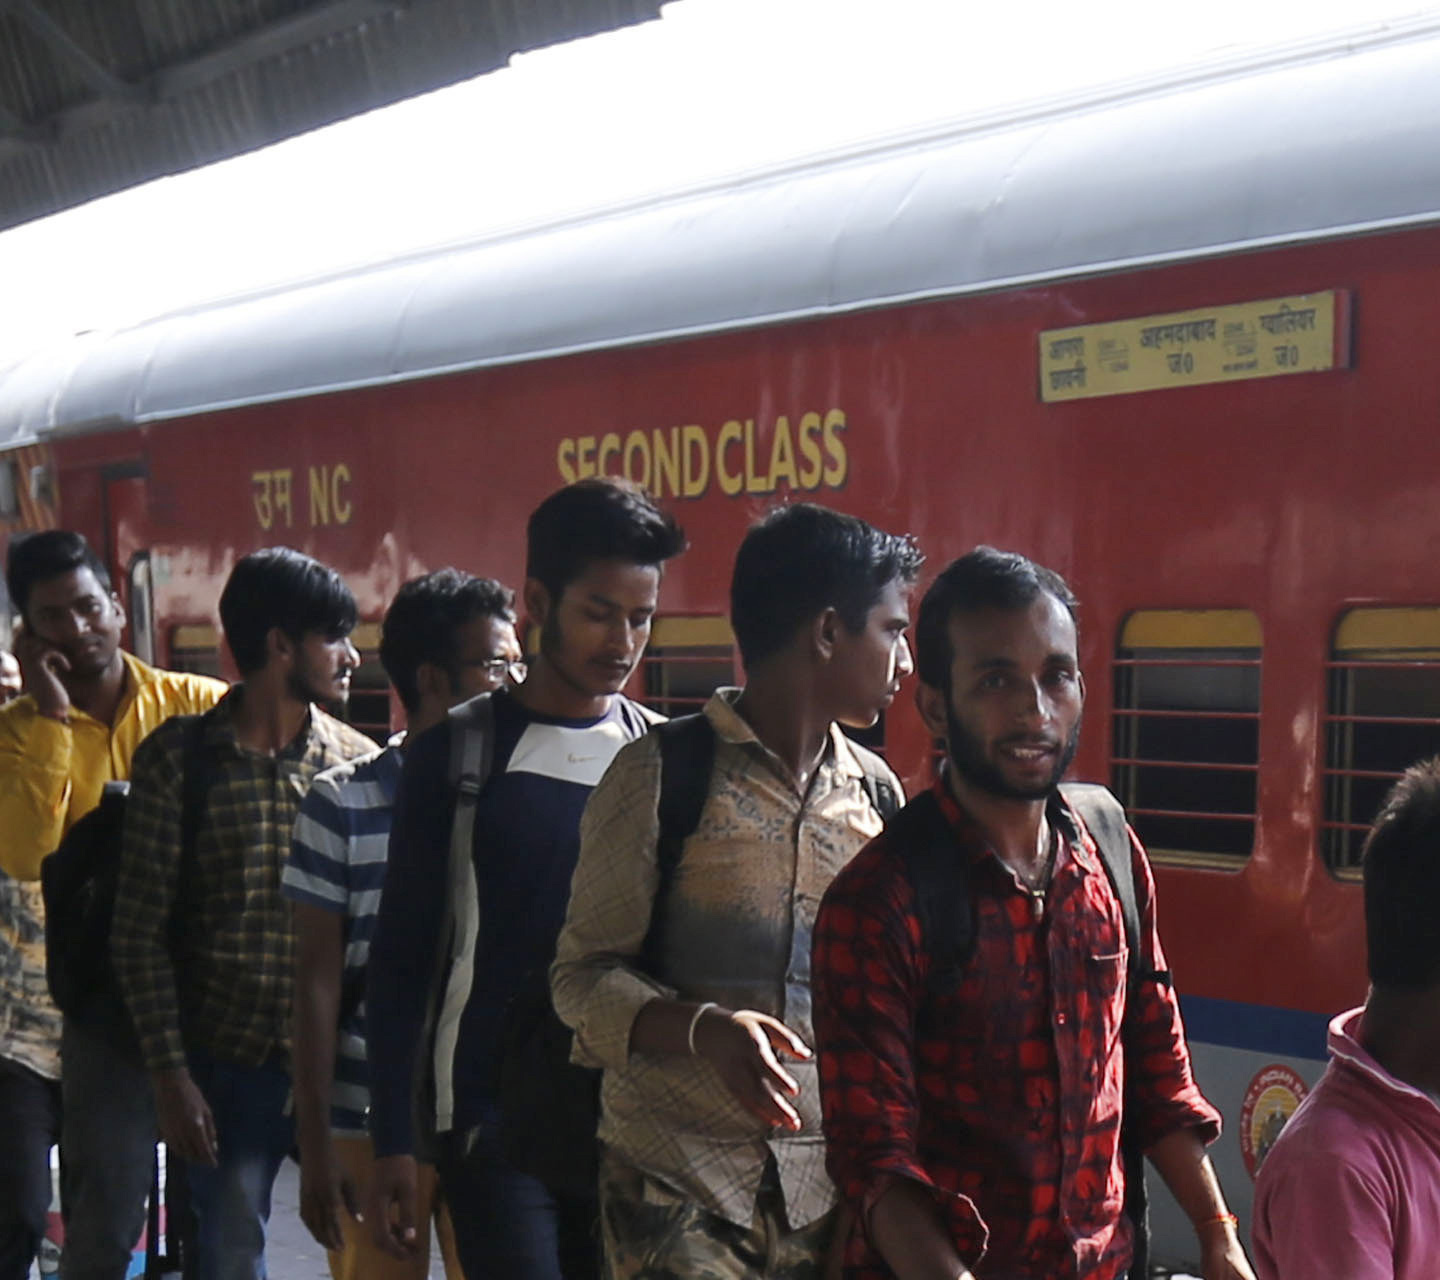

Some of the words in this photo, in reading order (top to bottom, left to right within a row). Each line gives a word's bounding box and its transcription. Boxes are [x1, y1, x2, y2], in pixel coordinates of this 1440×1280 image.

[556, 424, 710, 498] SECOND
[716, 408, 848, 494] CLASS
[308, 463, 352, 526] NC
